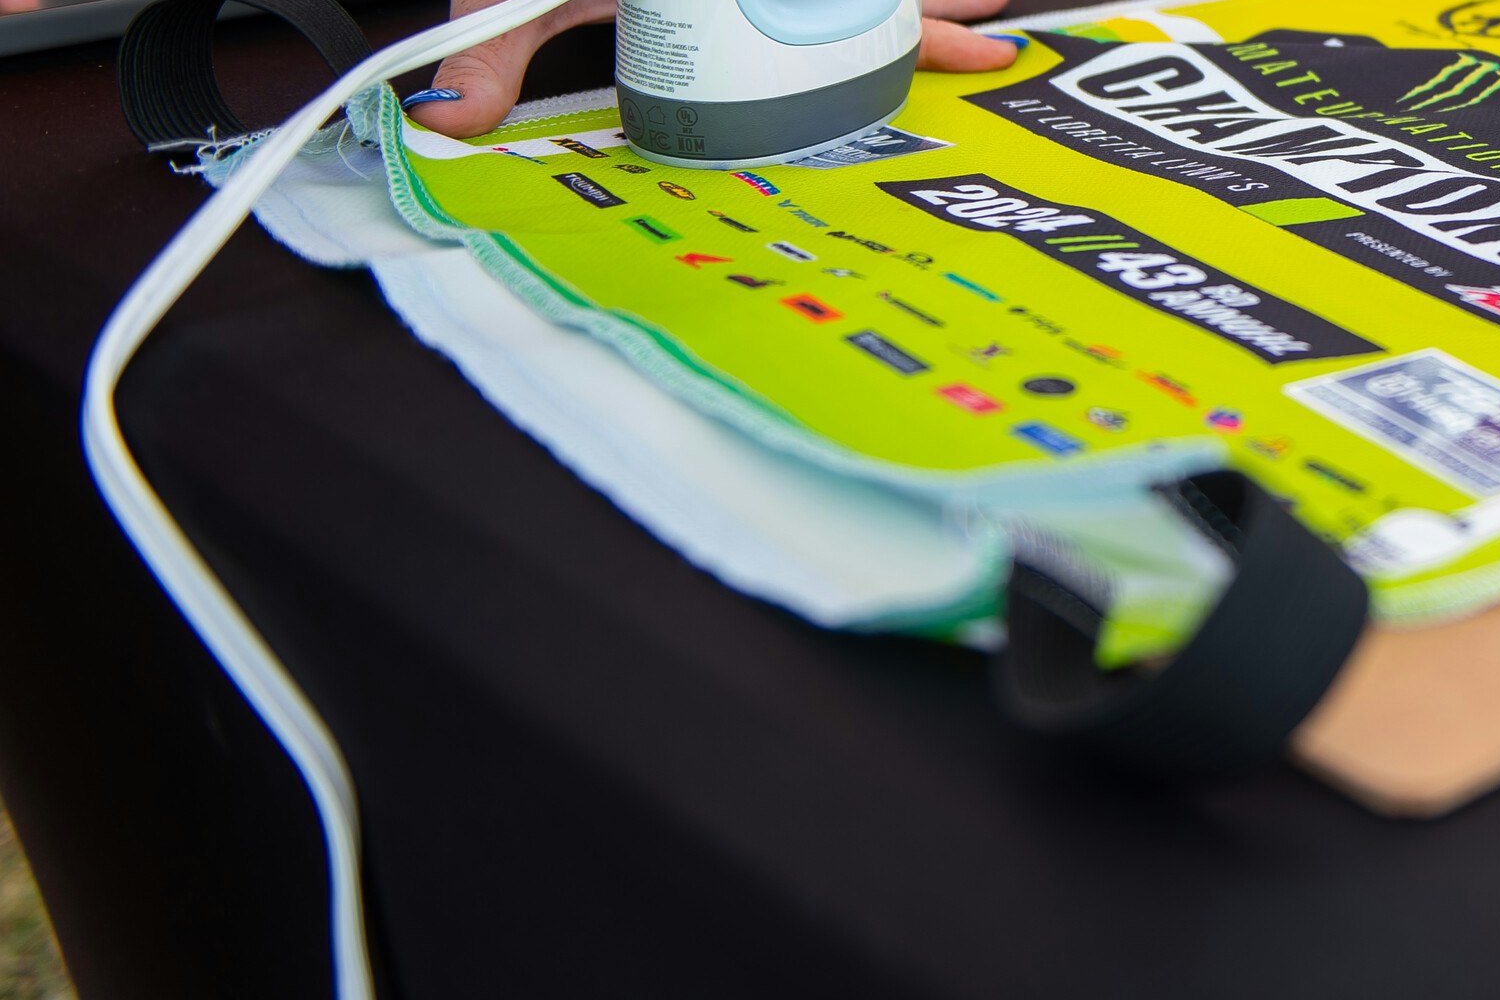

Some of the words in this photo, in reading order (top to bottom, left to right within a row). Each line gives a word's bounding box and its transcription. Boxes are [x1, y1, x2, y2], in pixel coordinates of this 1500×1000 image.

[650, 10, 662, 18] Mini
[666, 58, 689, 66] Operation
[1215, 42, 1385, 118] MATEUR
[680, 110, 693, 123] UL
[678, 138, 705, 152] NOM
[1001, 98, 1056, 113] AT
[1040, 115, 1165, 160] LORETTA
[1151, 158, 1270, 194] LYNN'S
[565, 174, 609, 202] TRIUMPH
[909, 184, 1096, 233] 2024
[1096, 251, 1208, 290] 43
[1345, 231, 1430, 268] PRESENTED
[1423, 265, 1454, 278] BY
[1199, 283, 1261, 307] RD
[1148, 289, 1312, 357] ANNUAL
